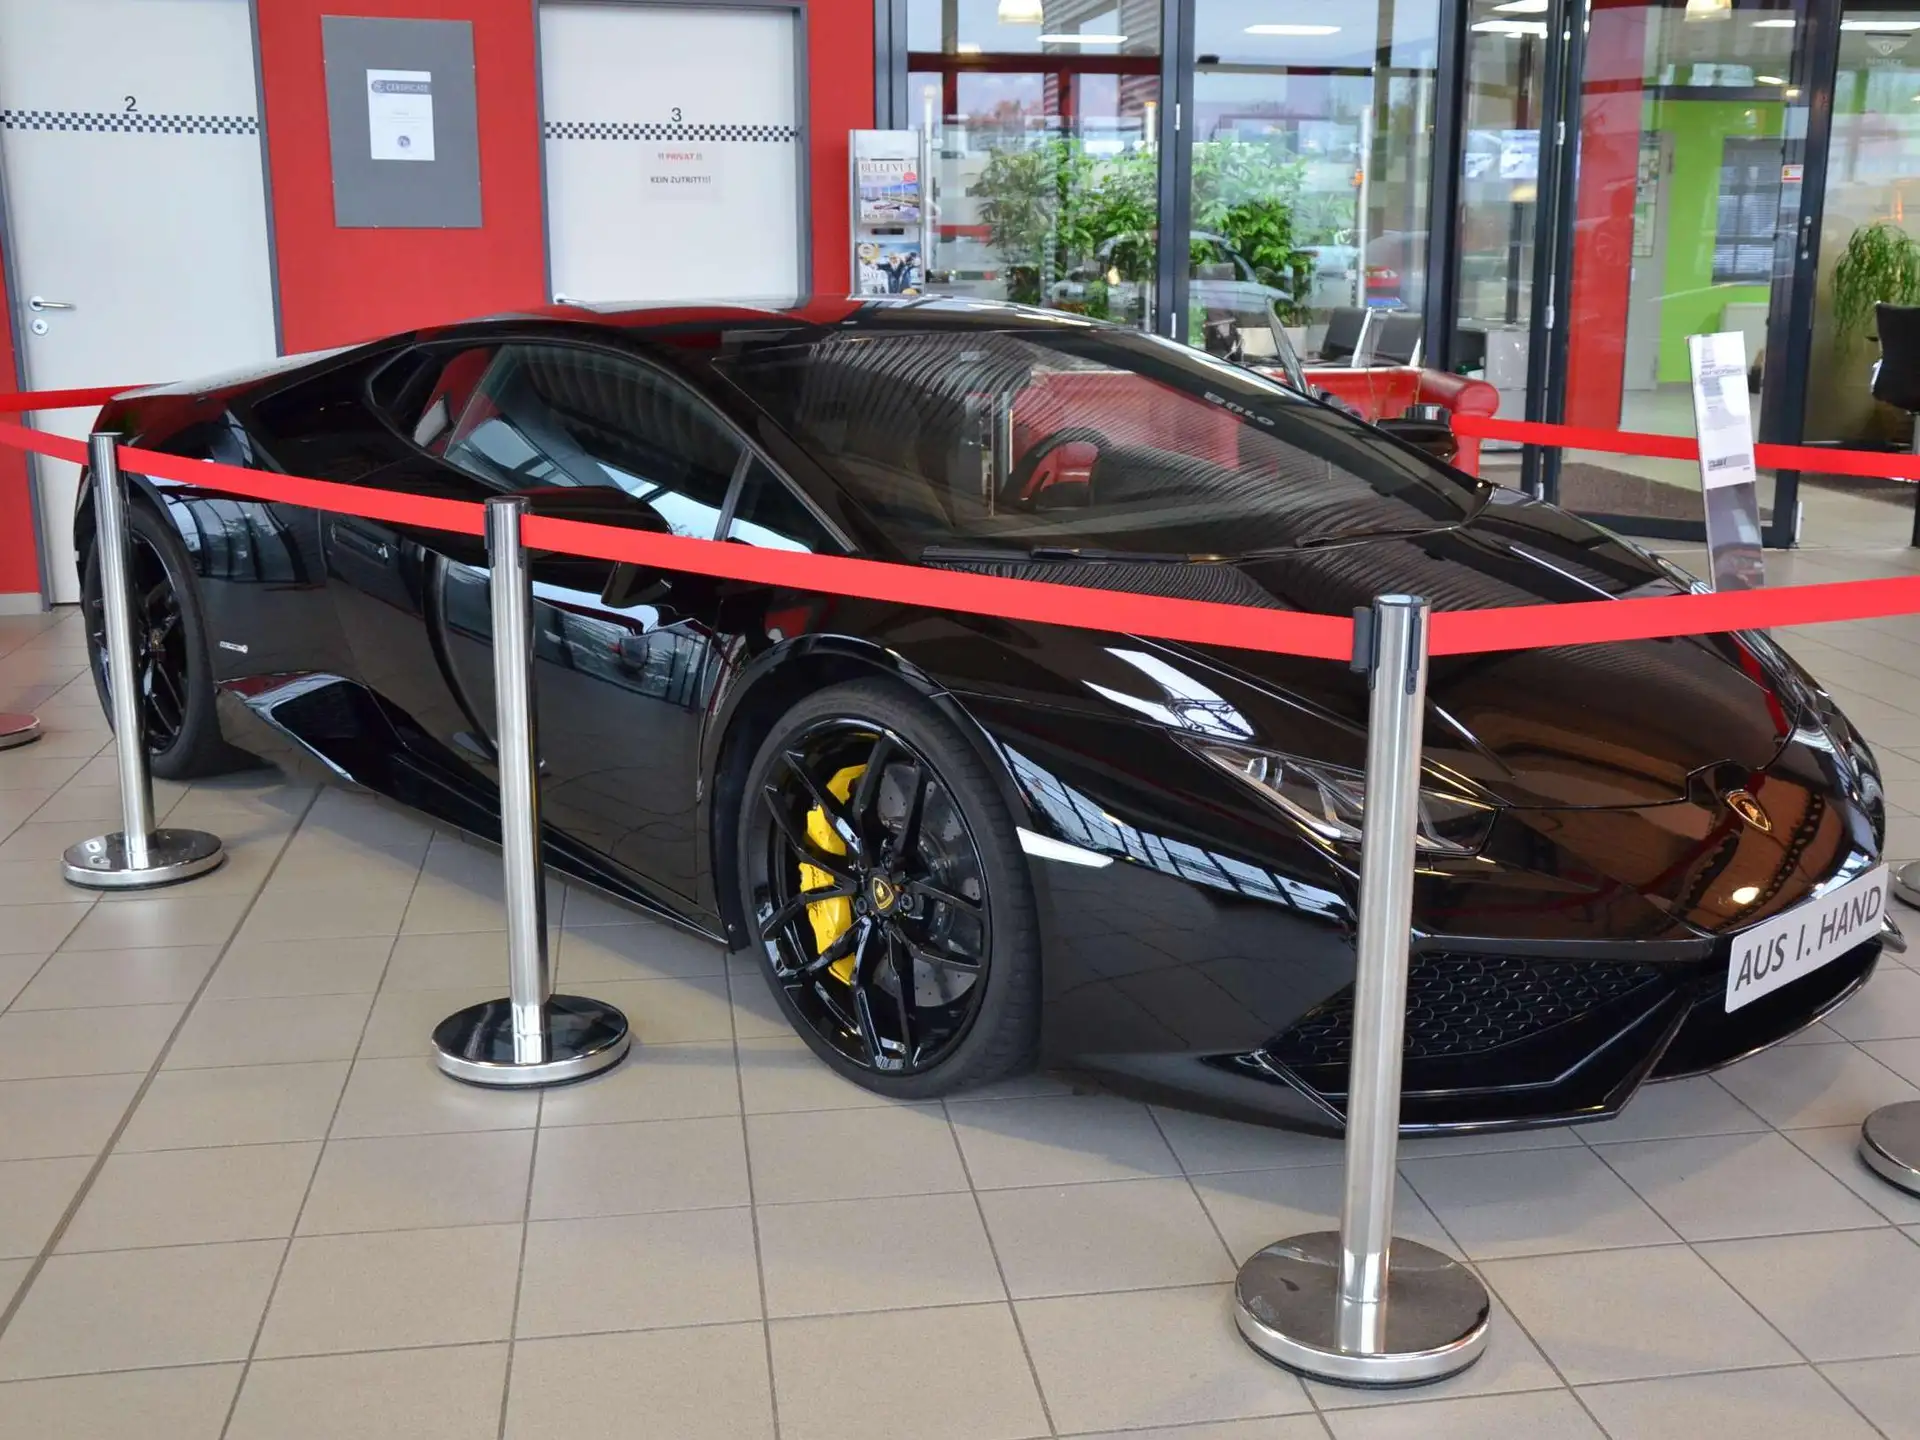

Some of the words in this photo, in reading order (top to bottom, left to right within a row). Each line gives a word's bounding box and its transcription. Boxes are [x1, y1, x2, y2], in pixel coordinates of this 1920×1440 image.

[124, 96, 138, 113] 2
[671, 107, 682, 122] 3
[666, 153, 695, 161] PRIVAT
[1734, 932, 1788, 992] AUS
[1795, 924, 1811, 961] I.
[1817, 886, 1881, 950] HAND
